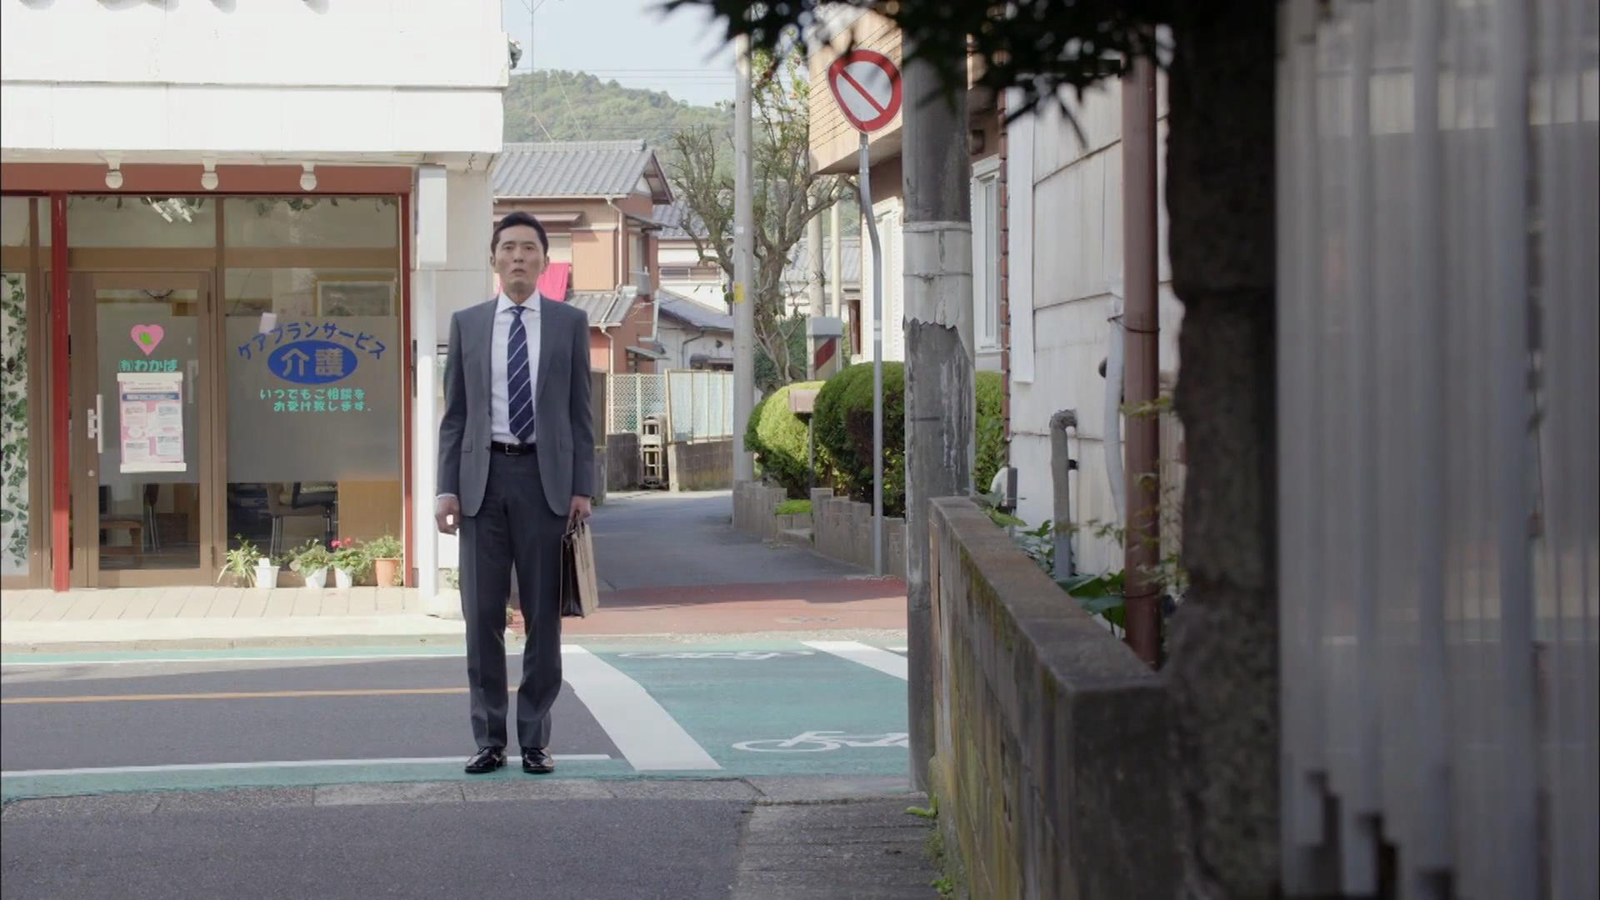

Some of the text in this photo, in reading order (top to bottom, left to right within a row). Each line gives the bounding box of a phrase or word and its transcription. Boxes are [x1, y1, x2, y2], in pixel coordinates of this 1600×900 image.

[281, 348, 344, 377] 介護
[260, 388, 365, 400] いつでもご相談を
